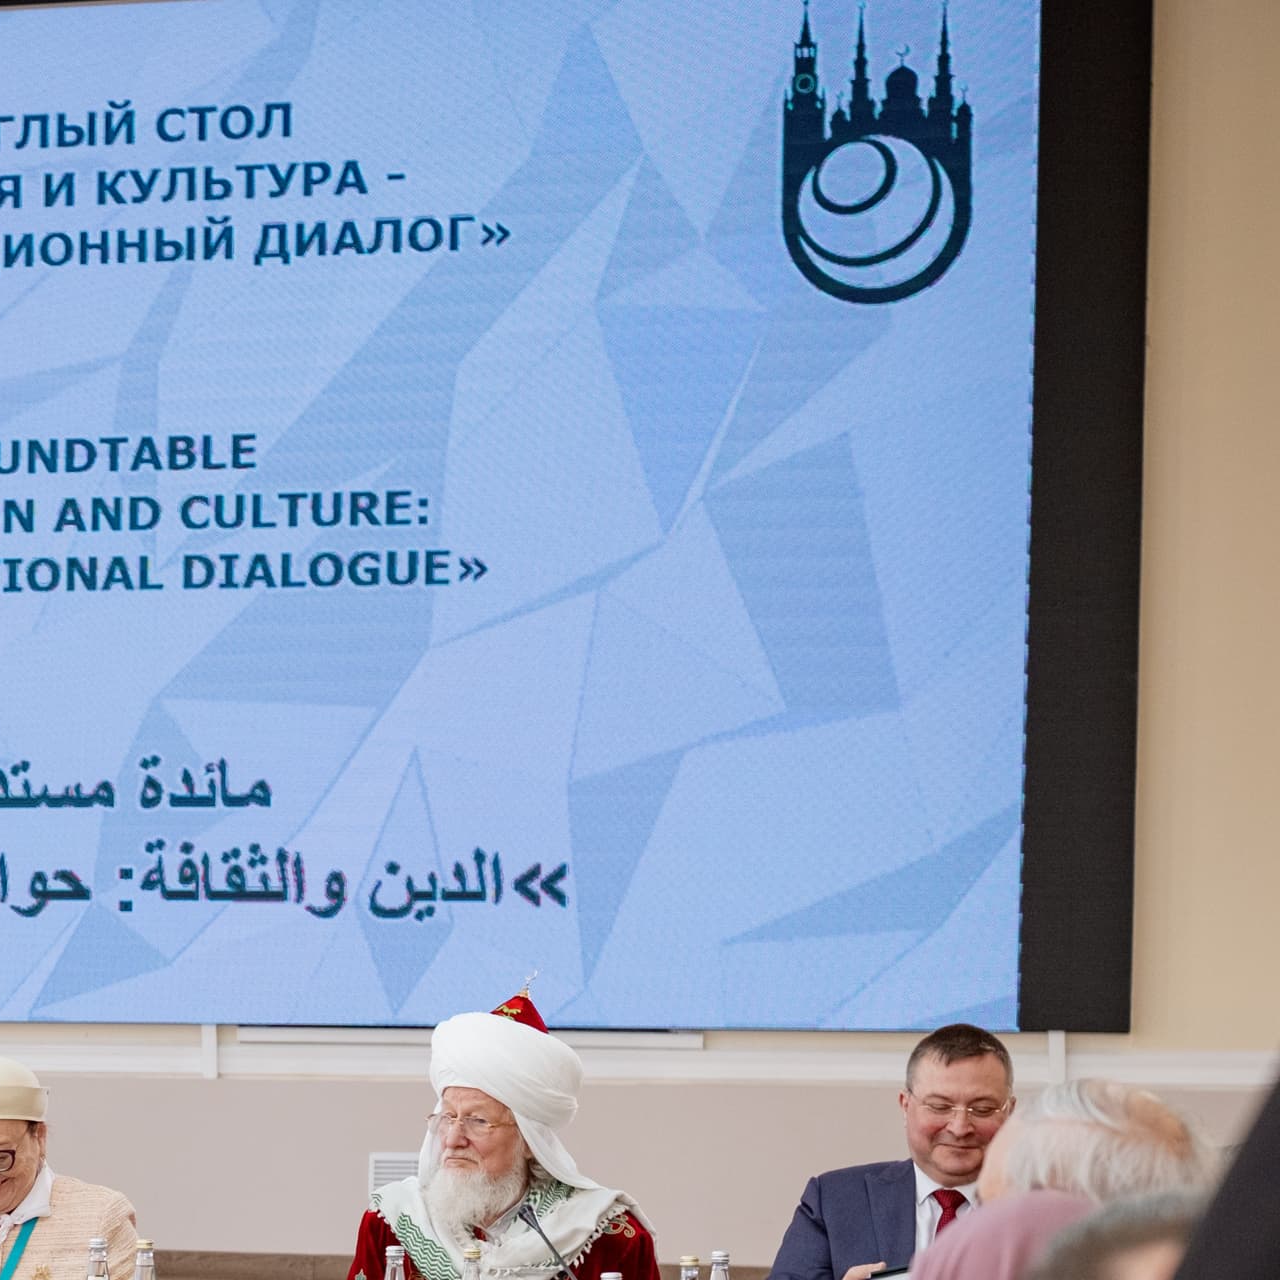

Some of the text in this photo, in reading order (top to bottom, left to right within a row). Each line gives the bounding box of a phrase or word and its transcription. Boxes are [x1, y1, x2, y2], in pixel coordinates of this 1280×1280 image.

[156, 102, 292, 142] СТОЛ
[44, 172, 75, 207] И
[97, 160, 368, 205] КУЛЬТУРА
[254, 215, 510, 266] ДИАЛОГ»
[54, 496, 161, 532] AND
[180, 491, 428, 529] CULTURE:
[183, 550, 488, 590] DIALOGUE»
[140, 755, 272, 808] مائدة
[119, 839, 347, 919] والثقافة:
